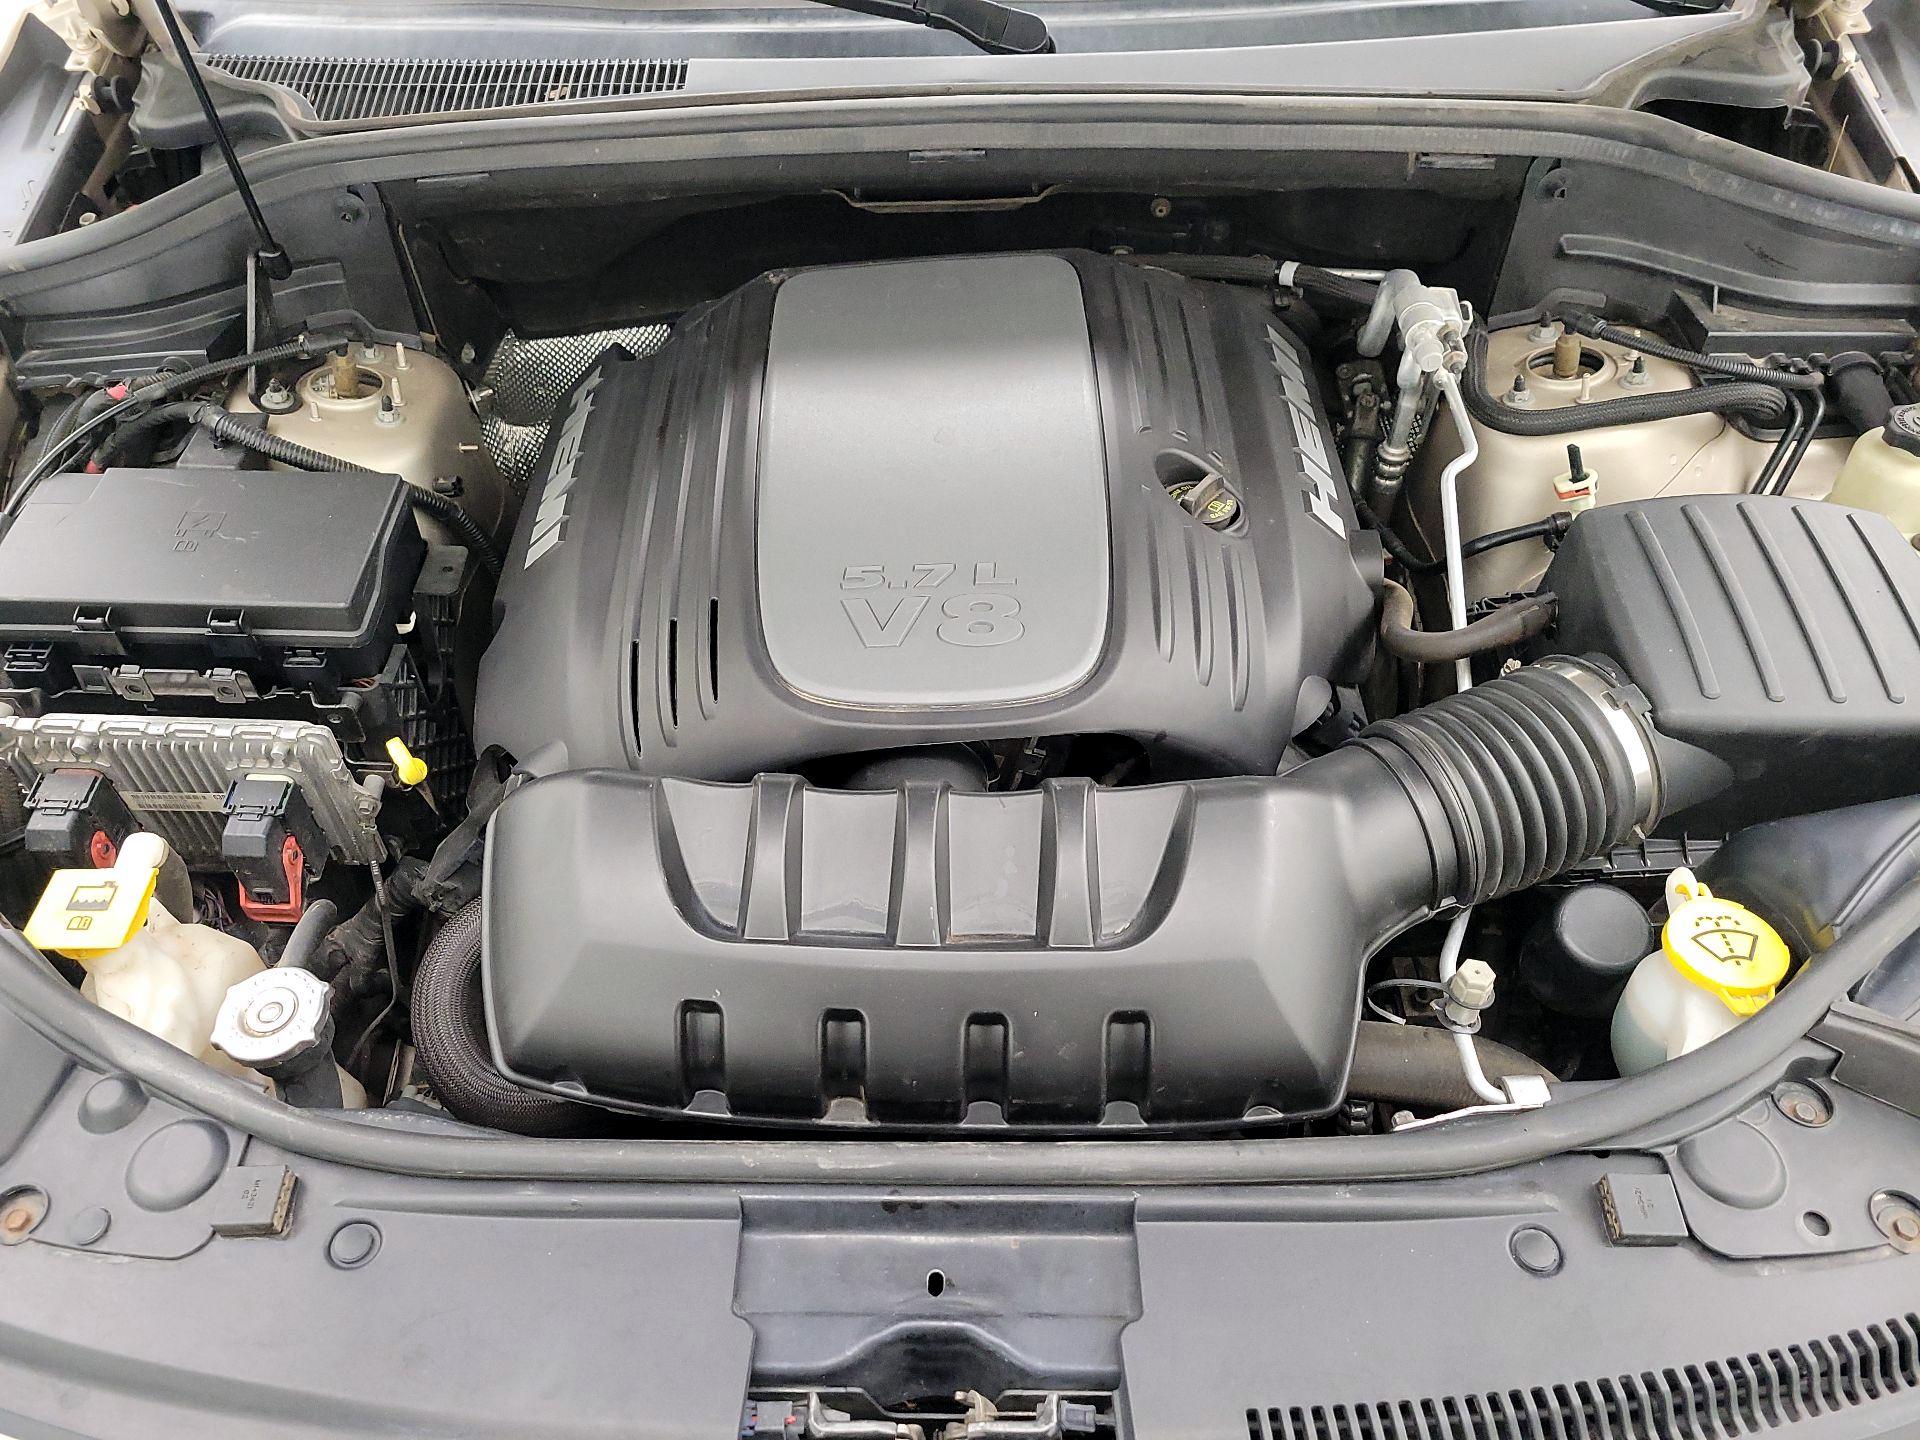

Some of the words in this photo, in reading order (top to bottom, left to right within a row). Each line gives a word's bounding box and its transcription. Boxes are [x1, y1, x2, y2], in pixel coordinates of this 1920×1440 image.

[524, 365, 603, 571] HEMI
[1265, 323, 1347, 540] HEMI
[839, 562, 957, 591] 5.7
[972, 561, 1018, 587] L
[840, 592, 1026, 649] V8
